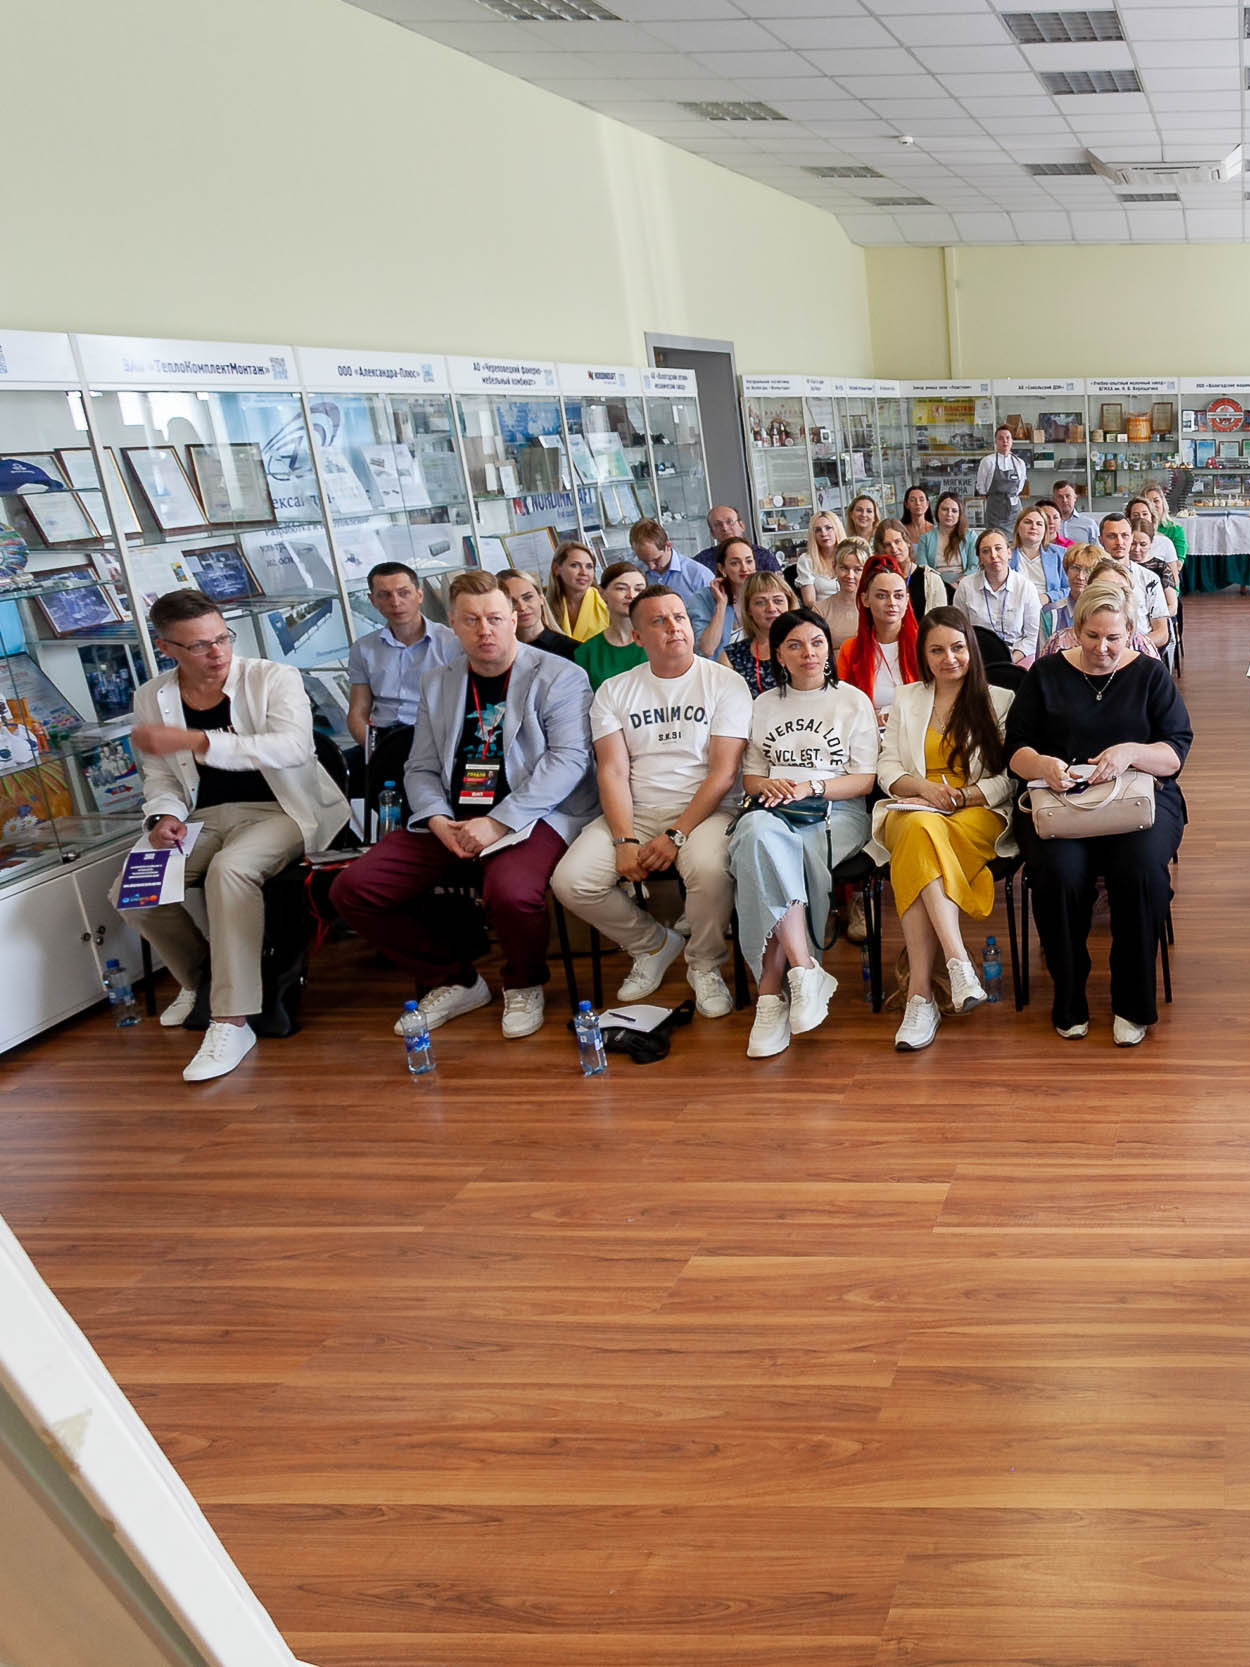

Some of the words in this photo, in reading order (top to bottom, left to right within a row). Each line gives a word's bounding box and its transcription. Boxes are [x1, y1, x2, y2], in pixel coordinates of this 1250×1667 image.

[337, 365, 353, 376] ООО
[531, 487, 593, 512] NORDINKAFT
[629, 705, 681, 729] DENIM
[684, 705, 708, 725] CO.
[775, 749, 796, 762] VCL
[800, 748, 823, 761] EST.
[822, 727, 844, 766] LOVE
